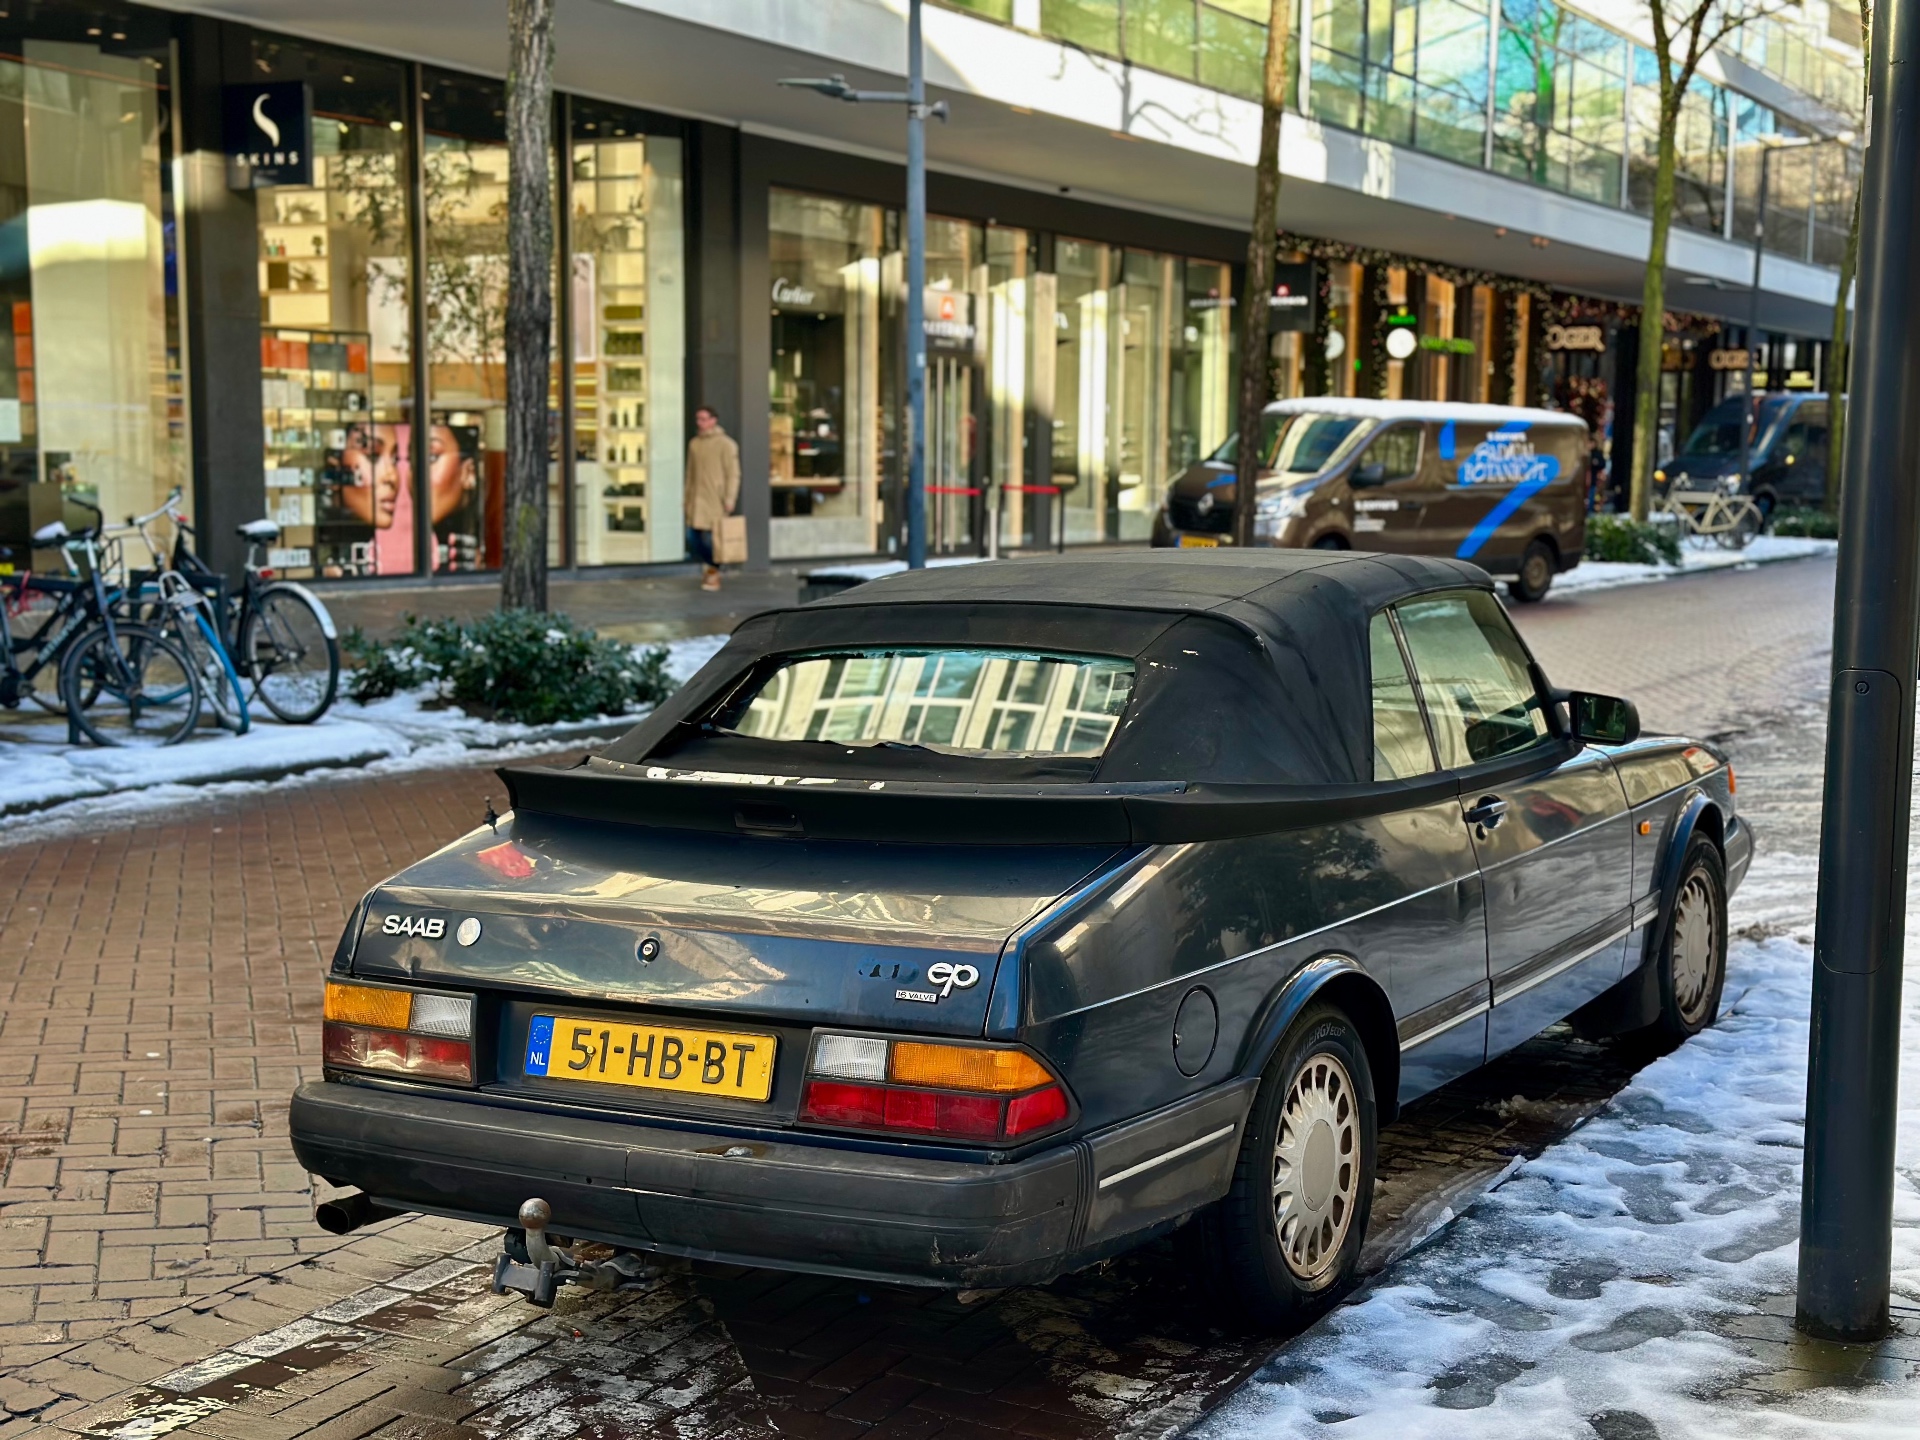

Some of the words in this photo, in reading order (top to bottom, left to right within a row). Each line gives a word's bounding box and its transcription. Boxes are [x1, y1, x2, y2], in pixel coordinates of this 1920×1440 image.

[236, 151, 299, 167] SKINS
[771, 277, 815, 305] Cartier
[1546, 324, 1606, 352] OGER
[382, 914, 446, 938] SAAB
[897, 991, 907, 999] 16
[908, 992, 934, 1001] VALVE
[529, 1051, 546, 1066] NL
[567, 1027, 755, 1087] 51-HB-BT
